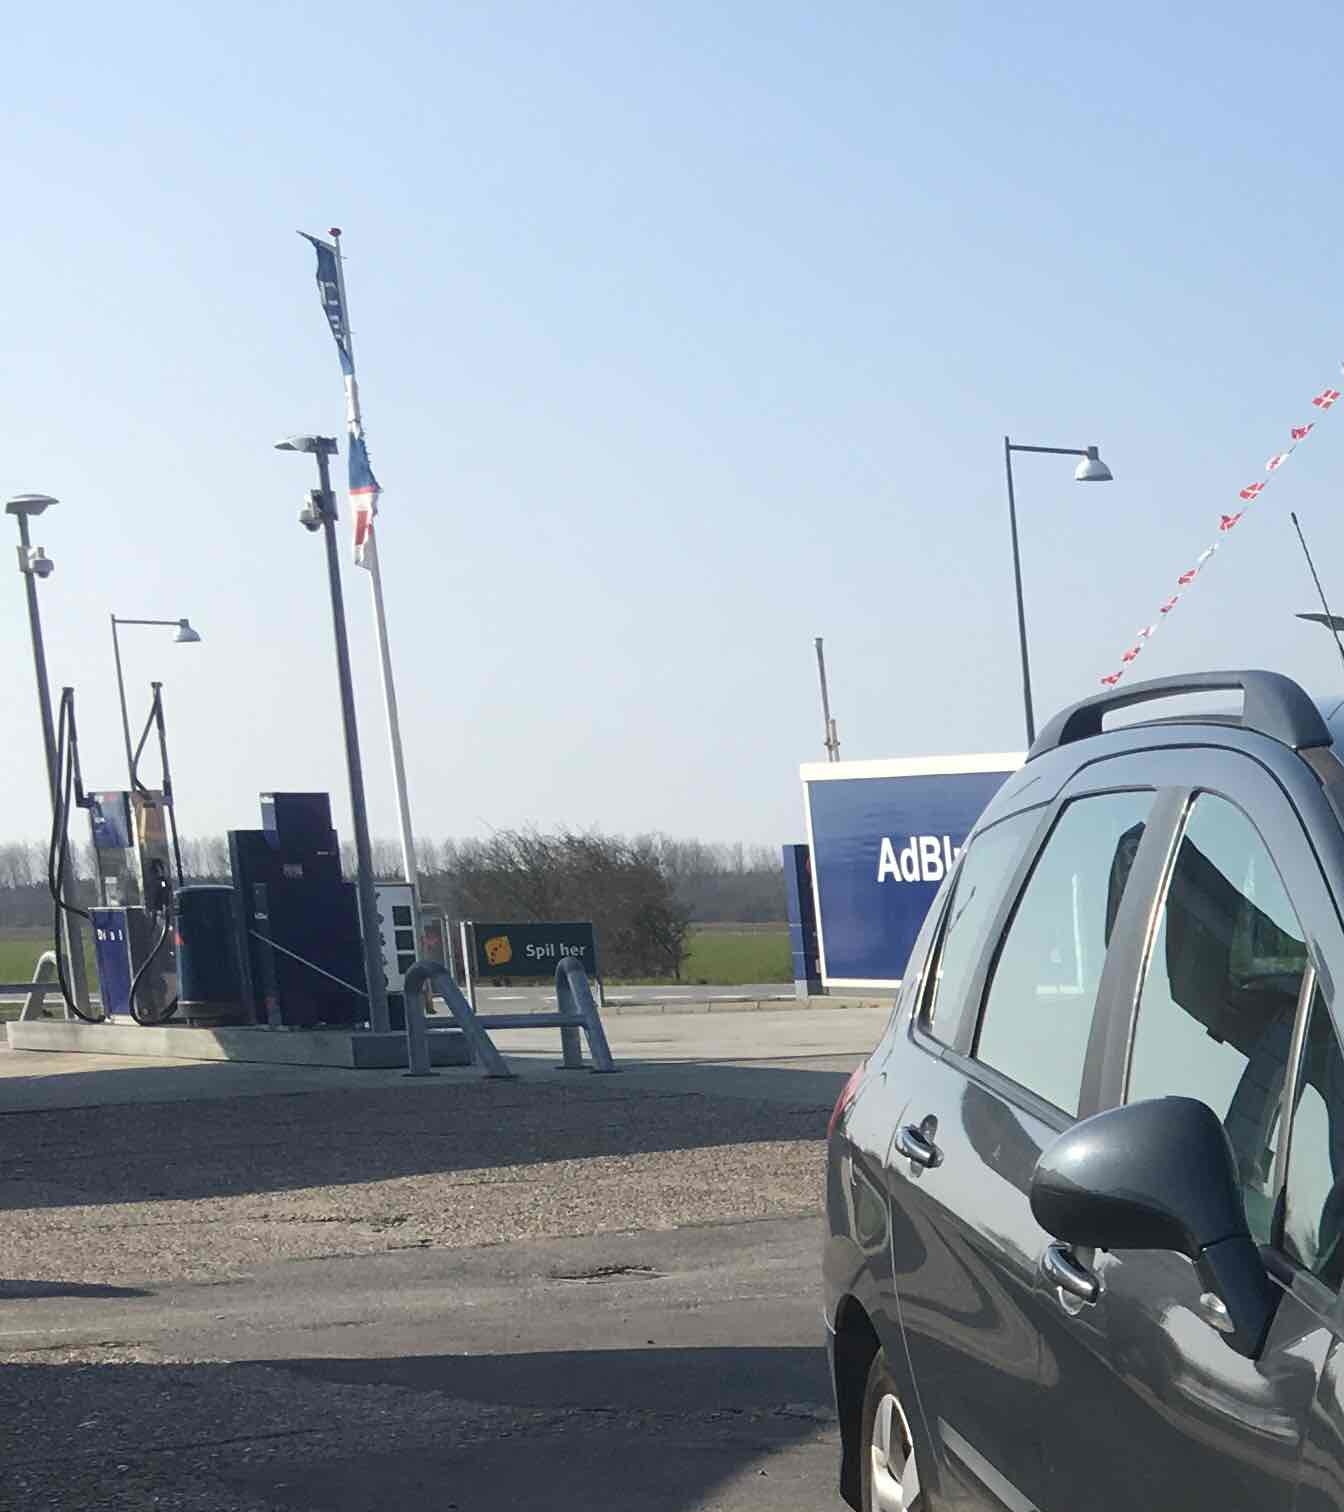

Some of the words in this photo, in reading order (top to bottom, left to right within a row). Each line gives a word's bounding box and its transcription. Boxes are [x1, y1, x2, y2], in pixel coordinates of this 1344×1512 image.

[877, 835, 961, 882] AdBl
[525, 943, 554, 960] Spil
[560, 943, 585, 957] her
